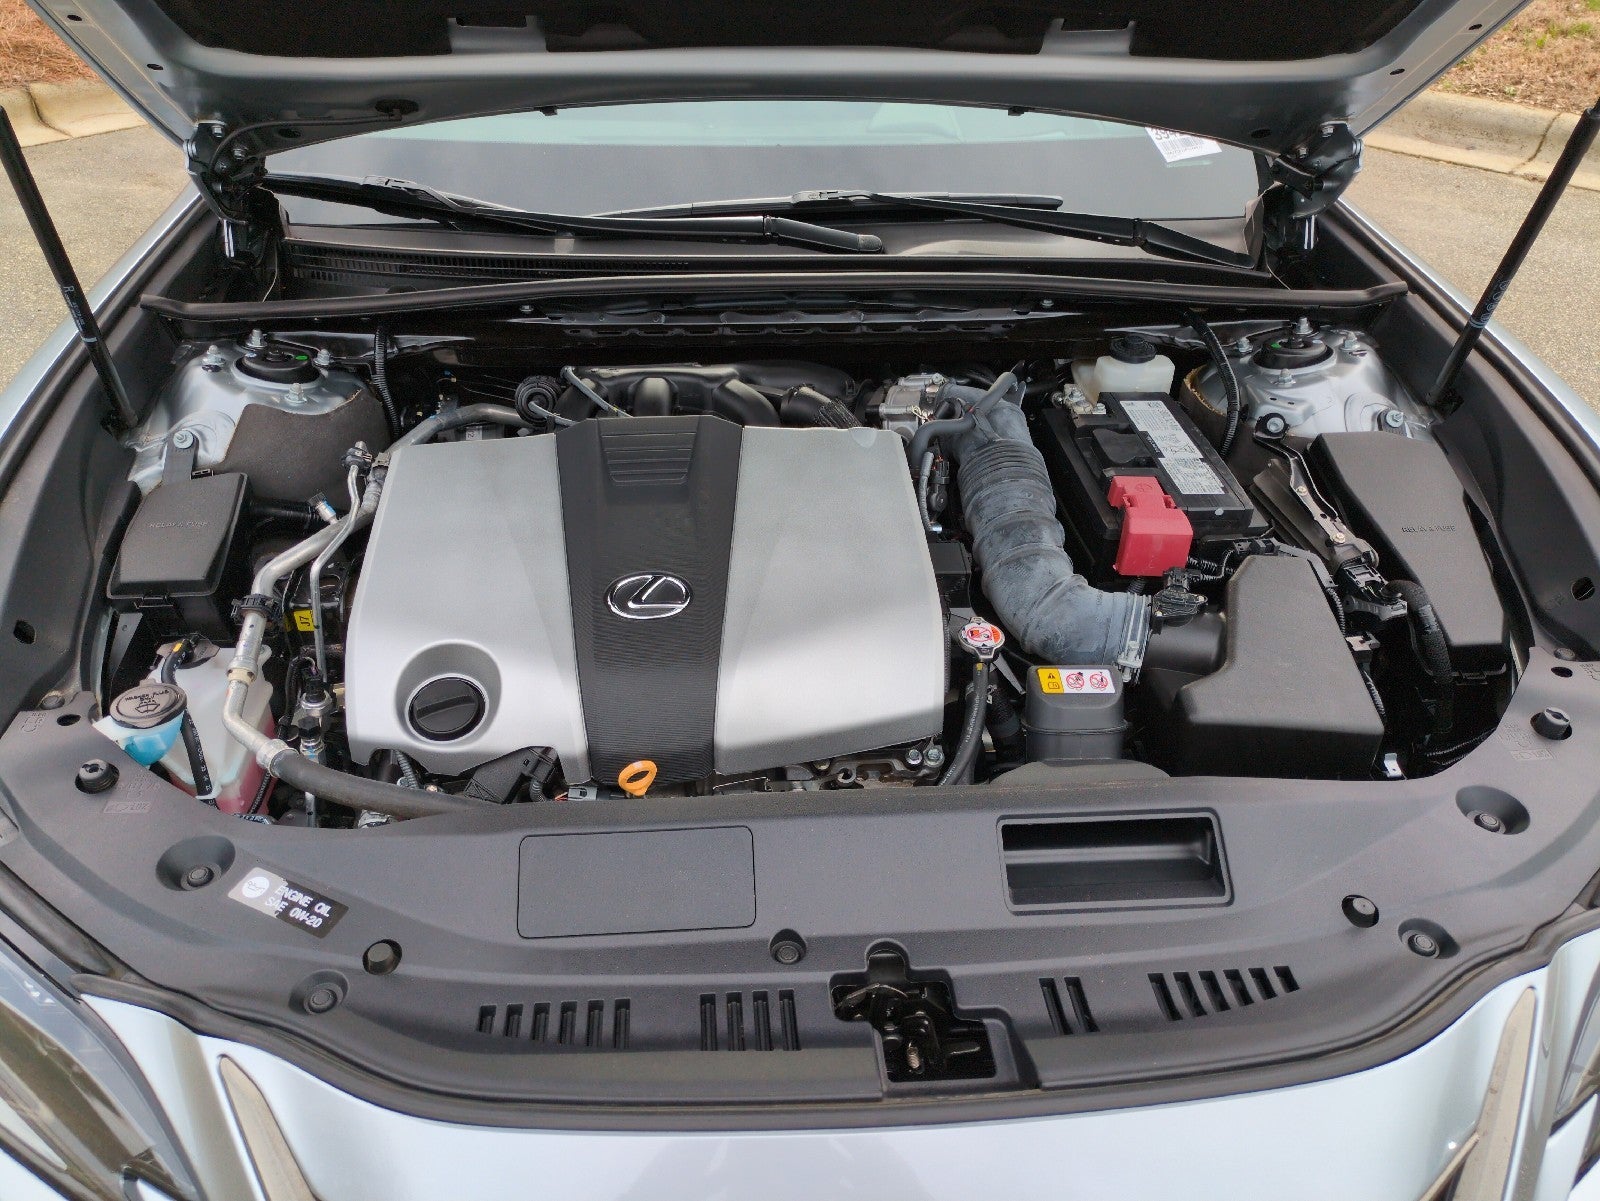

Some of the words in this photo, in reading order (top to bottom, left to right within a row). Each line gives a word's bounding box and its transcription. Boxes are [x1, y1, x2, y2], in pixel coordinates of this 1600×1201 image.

[265, 896, 289, 912] SAE
[289, 907, 323, 928] 0W-20
[275, 885, 313, 907] ENGINE
[314, 902, 332, 917] OIL
